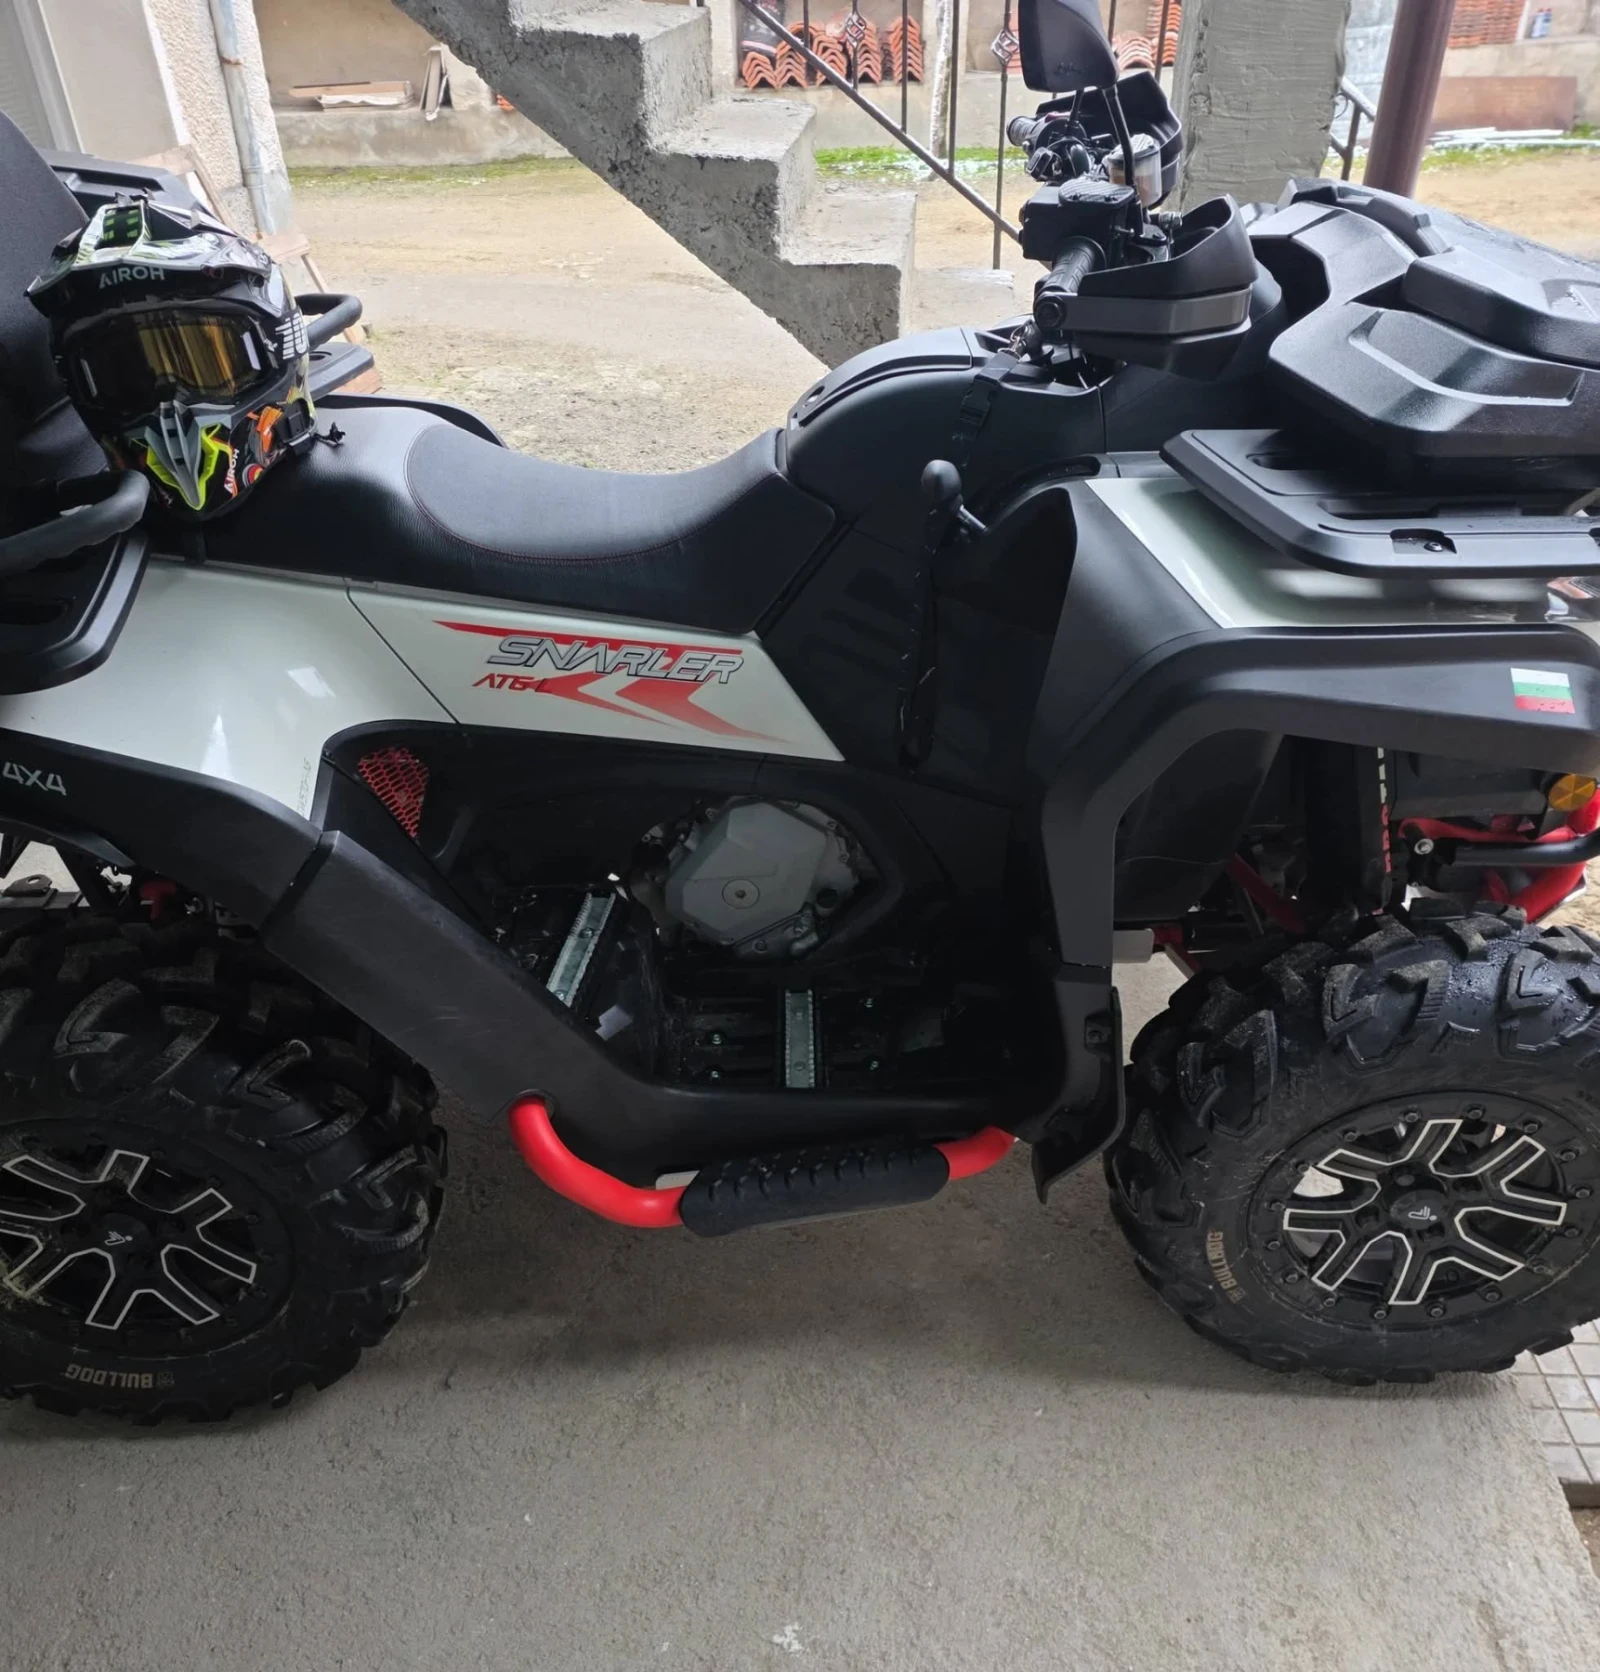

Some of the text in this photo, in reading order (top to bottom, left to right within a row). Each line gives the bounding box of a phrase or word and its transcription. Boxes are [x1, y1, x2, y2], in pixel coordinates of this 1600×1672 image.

[100, 265, 164, 289] AIROH
[224, 448, 240, 495] AIROH
[487, 635, 744, 684] SNARLER
[1206, 1231, 1238, 1290] BULLDOG
[65, 1364, 153, 1388] BULLDOG
